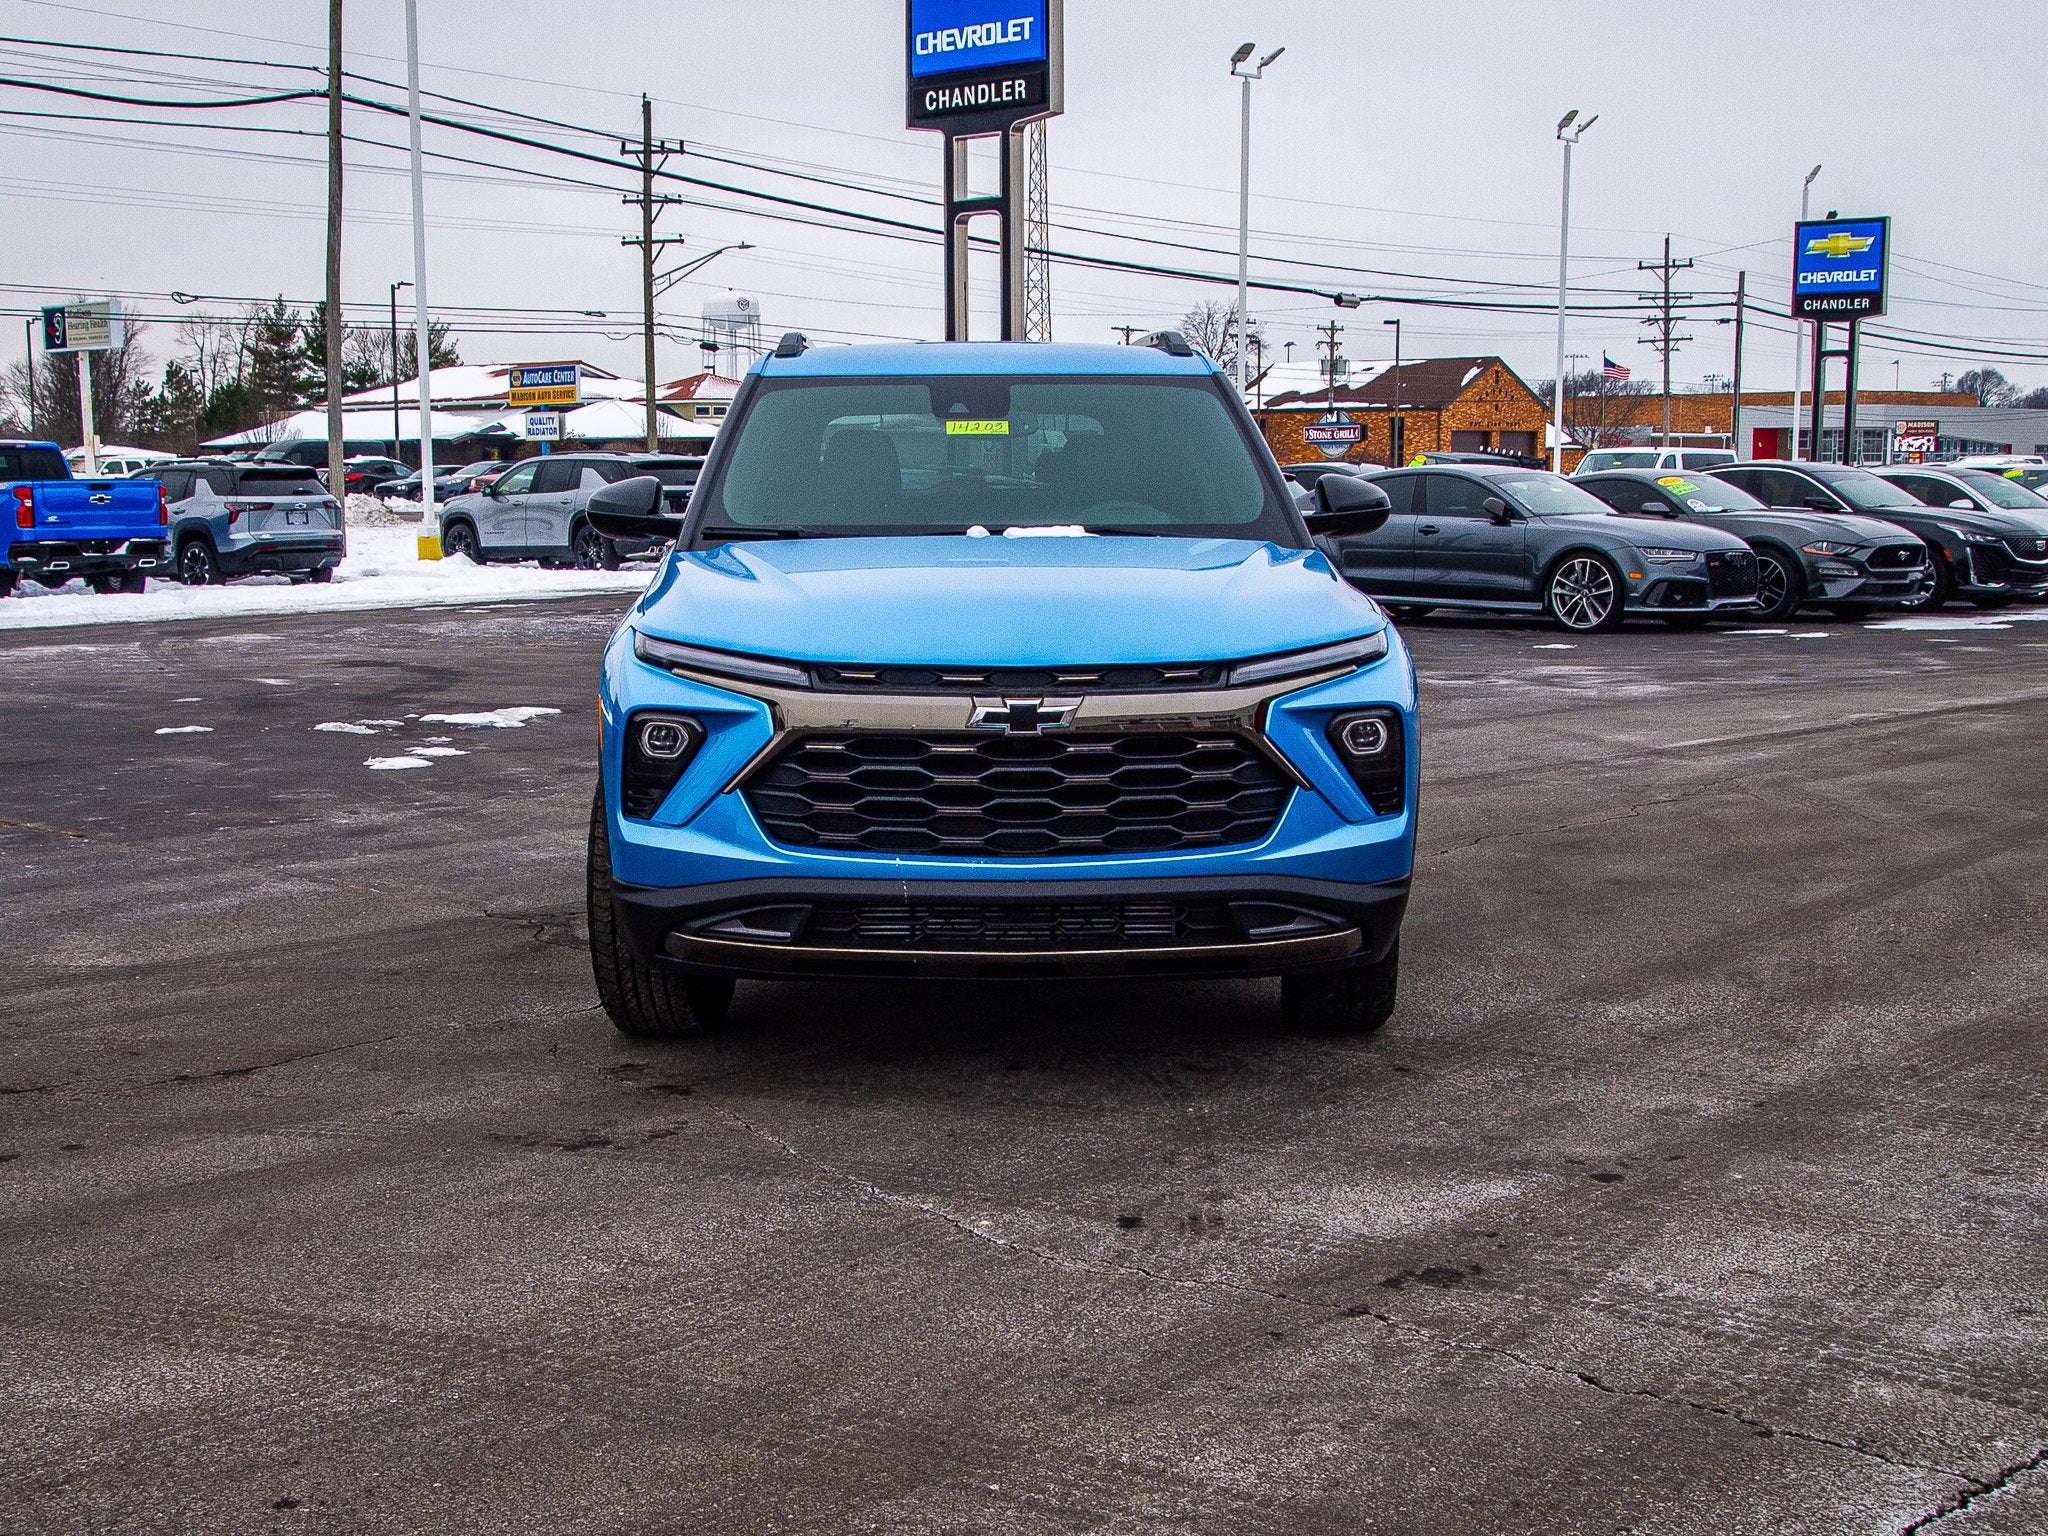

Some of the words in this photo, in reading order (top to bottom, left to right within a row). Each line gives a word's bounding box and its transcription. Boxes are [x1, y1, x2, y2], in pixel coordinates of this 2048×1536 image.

[915, 17, 1034, 55] CHEVROLET
[925, 79, 1026, 111] CHANDLER
[1799, 269, 1877, 284] CHEVROLET
[1803, 298, 1870, 310] CHANDLER
[529, 416, 555, 426] QUALITY
[527, 427, 558, 436] RADIATOR
